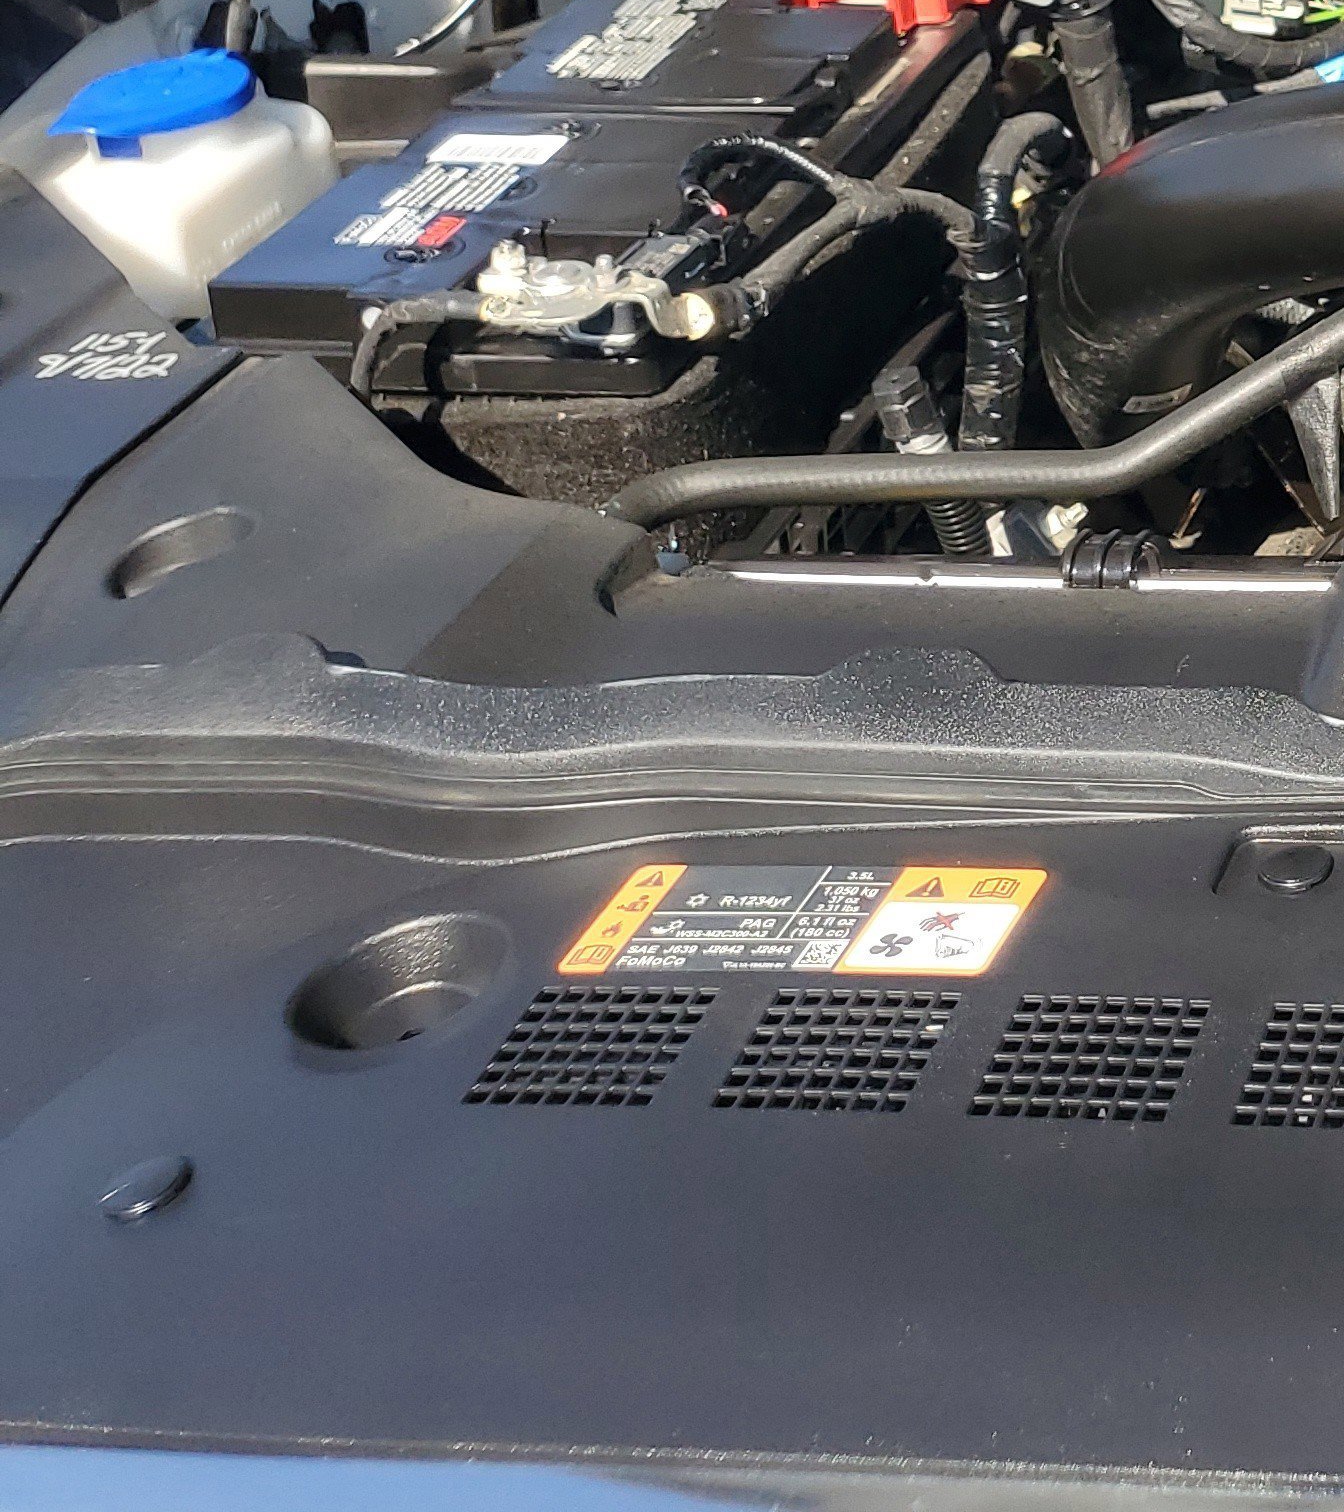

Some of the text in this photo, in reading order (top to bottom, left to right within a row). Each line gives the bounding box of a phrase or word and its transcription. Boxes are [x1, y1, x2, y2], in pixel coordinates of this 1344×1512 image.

[847, 871, 875, 880] 3.5L
[823, 886, 880, 898] 1.050 kg
[720, 895, 793, 908] R-1234yf
[841, 904, 861, 912] lbs
[739, 918, 777, 928] PAG
[798, 916, 858, 926] 6.1 fl oz
[790, 928, 851, 938] (180 cc)
[627, 945, 660, 954] SAE
[662, 945, 699, 954] J639
[615, 955, 687, 966] FoMoCo
